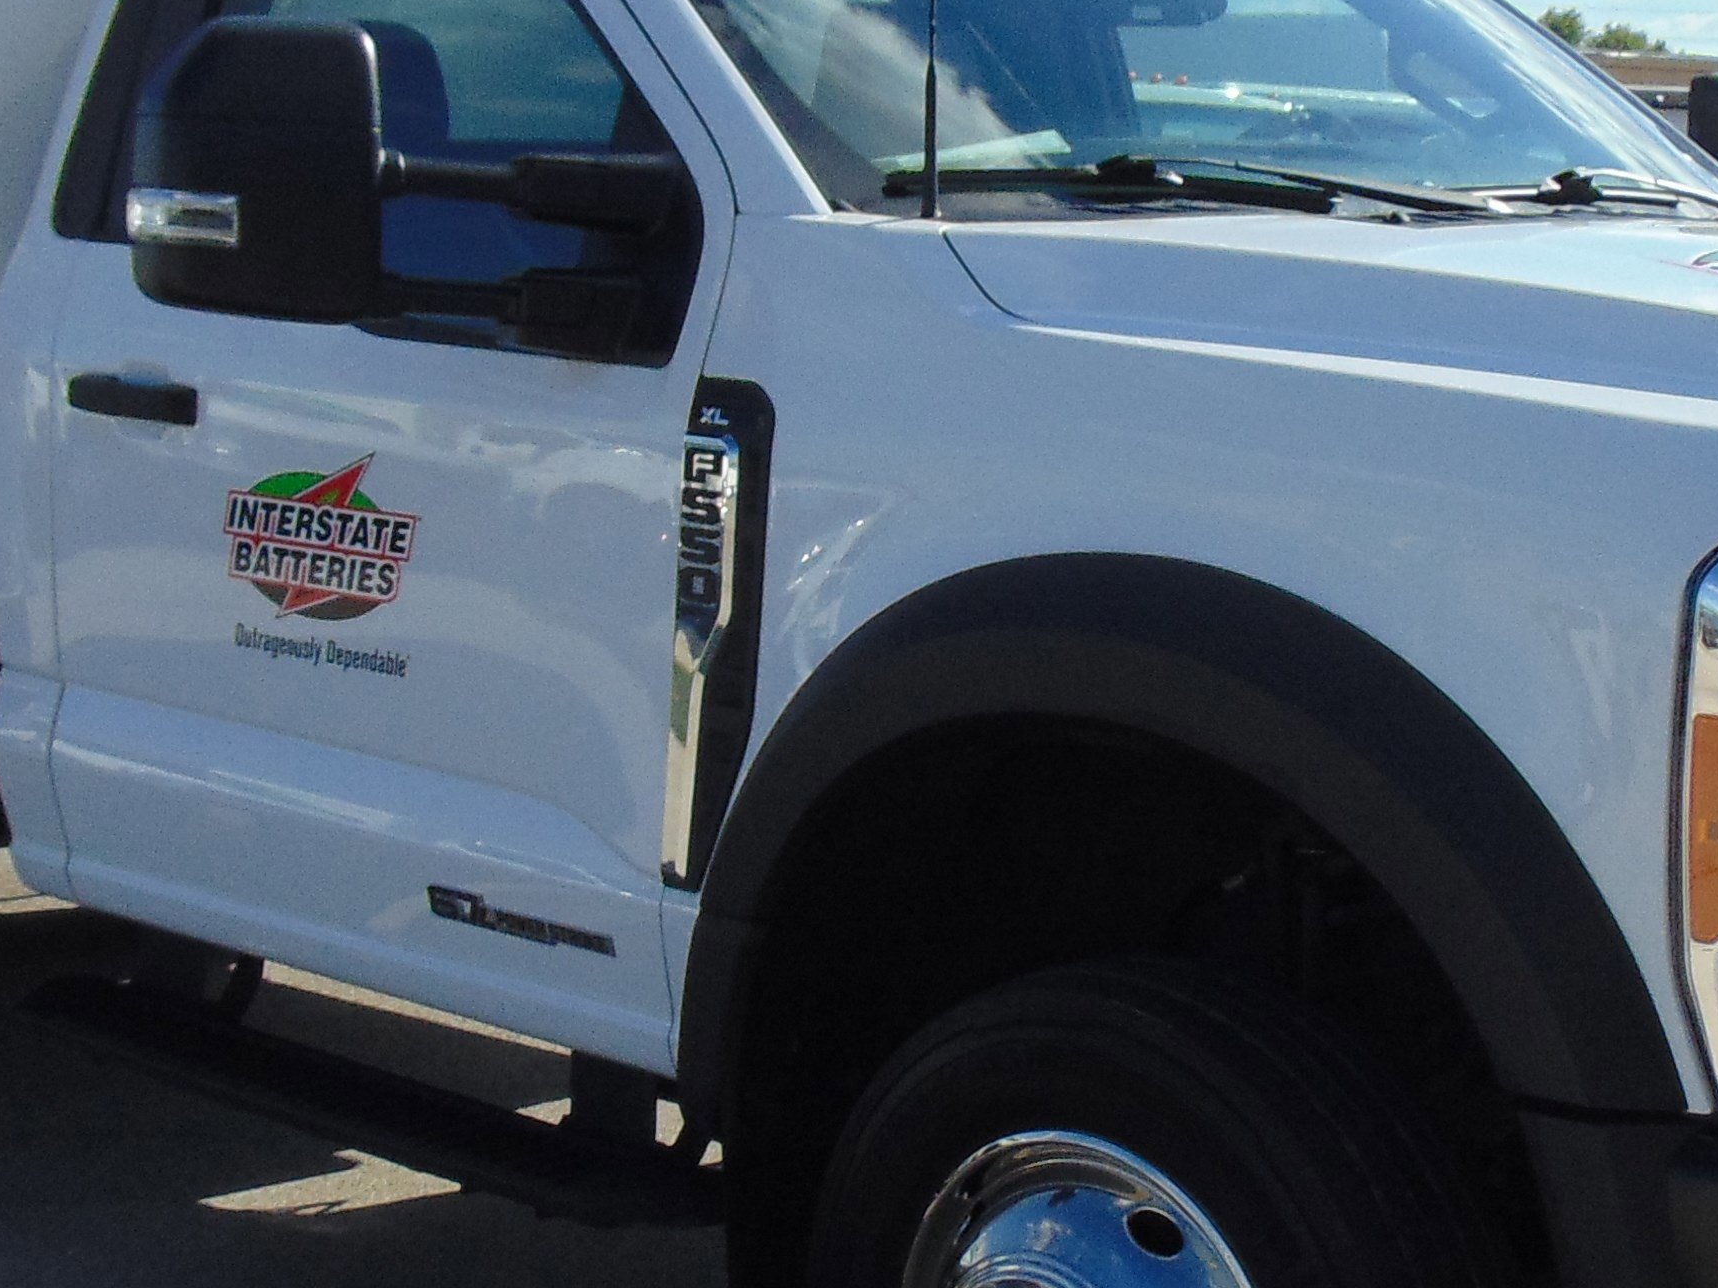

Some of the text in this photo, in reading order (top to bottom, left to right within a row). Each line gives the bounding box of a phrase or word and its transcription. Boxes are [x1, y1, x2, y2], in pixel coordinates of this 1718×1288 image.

[699, 405, 730, 427] XL
[227, 496, 412, 555] INTERSTATE
[233, 541, 398, 597] BATTERIES
[325, 639, 407, 678] Dependable
